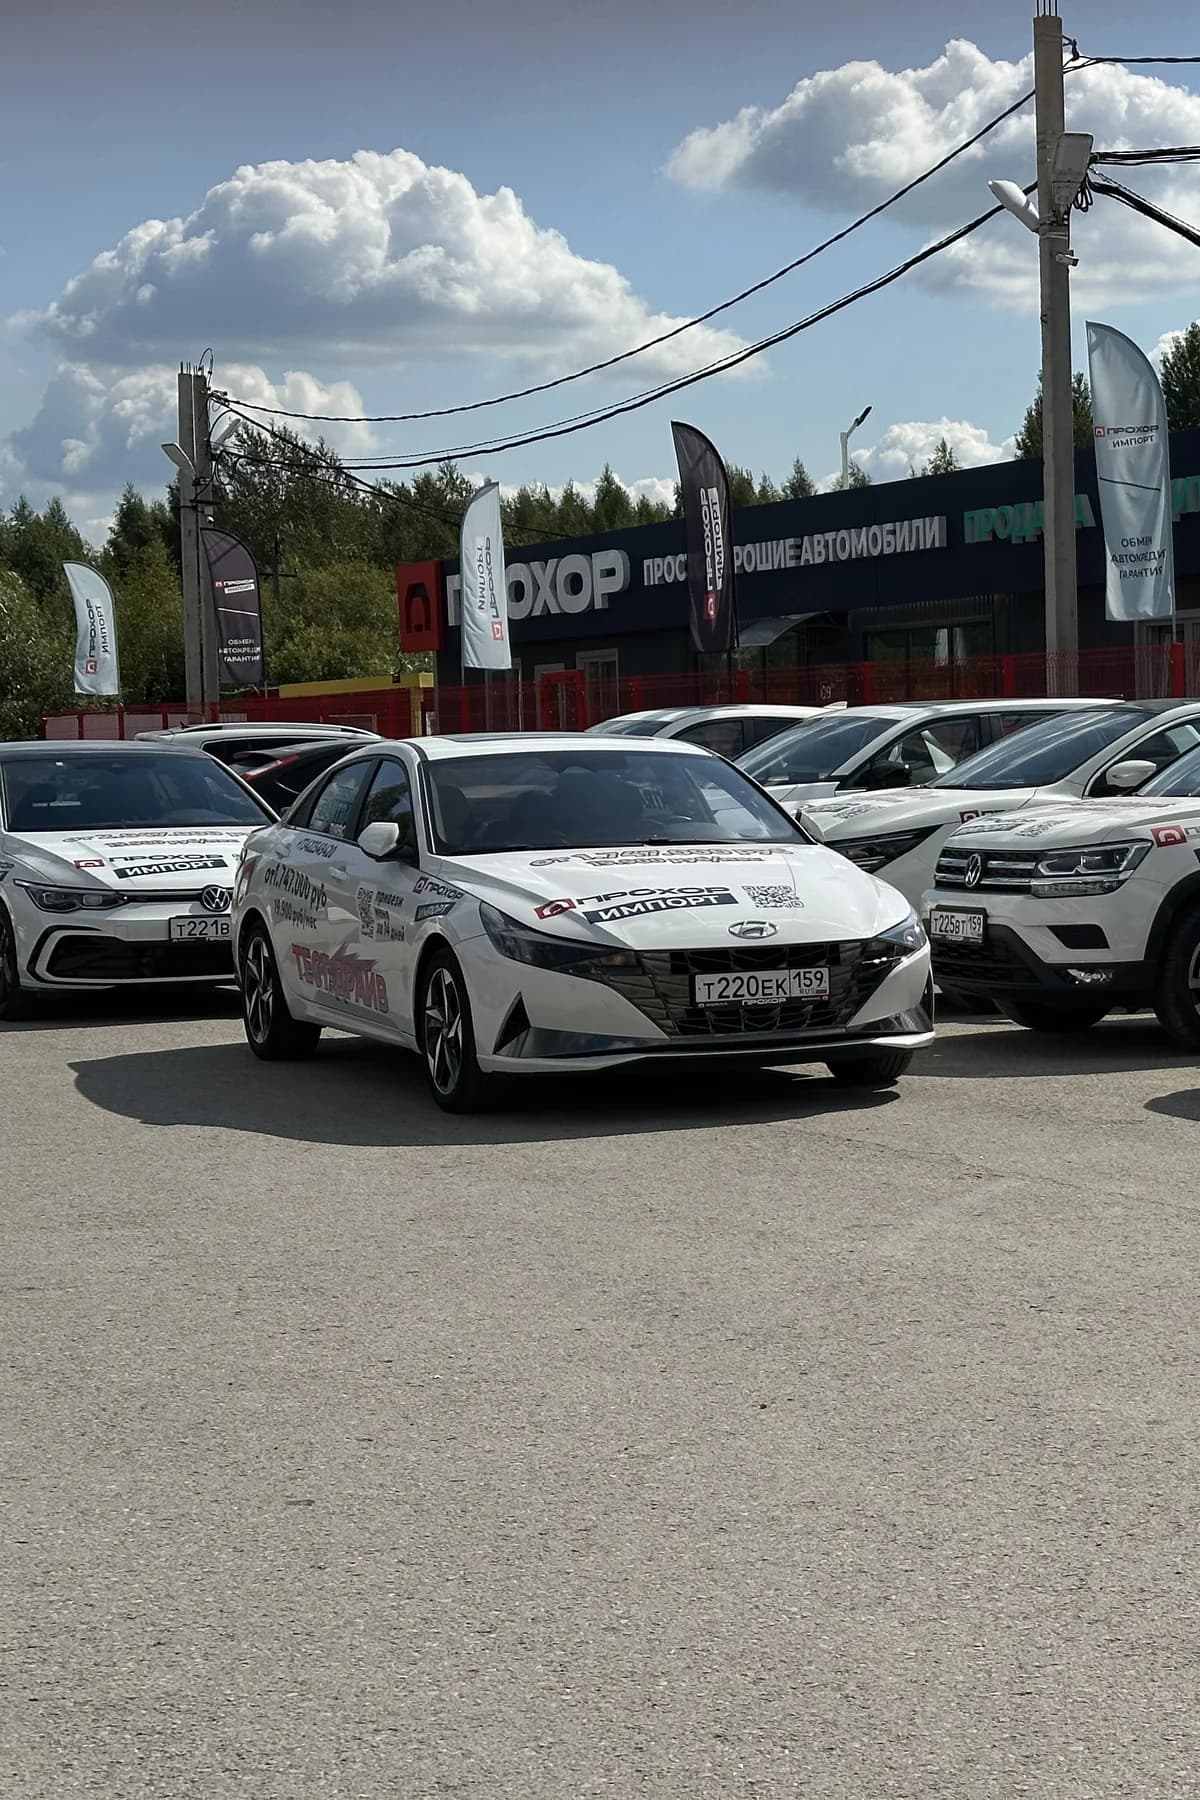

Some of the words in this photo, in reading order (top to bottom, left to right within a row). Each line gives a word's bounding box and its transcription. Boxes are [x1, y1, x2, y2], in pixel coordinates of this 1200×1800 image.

[1106, 424, 1159, 435] ПРОХОР
[1112, 434, 1155, 449] ИМПОРТ
[963, 493, 1096, 543] ПРОДАА
[700, 487, 713, 591] ПРОХОР
[643, 553, 688, 587] ПРОС
[733, 538, 799, 575] РОШИЕ
[800, 516, 948, 567] АВТОМОБИЛИ
[446, 549, 630, 627] ОХОР
[86, 598, 97, 658] ПРОХОР
[95, 604, 110, 654] ИМПОРТ
[108, 854, 224, 863] ПРОХОР
[125, 859, 215, 876] ИМПОРТ
[310, 882, 328, 912] руб
[424, 881, 465, 902] ПРОХОР
[576, 886, 731, 906] ПРОХОР
[599, 894, 721, 921] ИМПОРТ
[176, 919, 230, 938] Т221В
[968, 915, 982, 931] 159
[703, 975, 788, 1000] Т220ЕК
[792, 970, 824, 988] 159
[741, 997, 787, 1006] ПРОХОР
